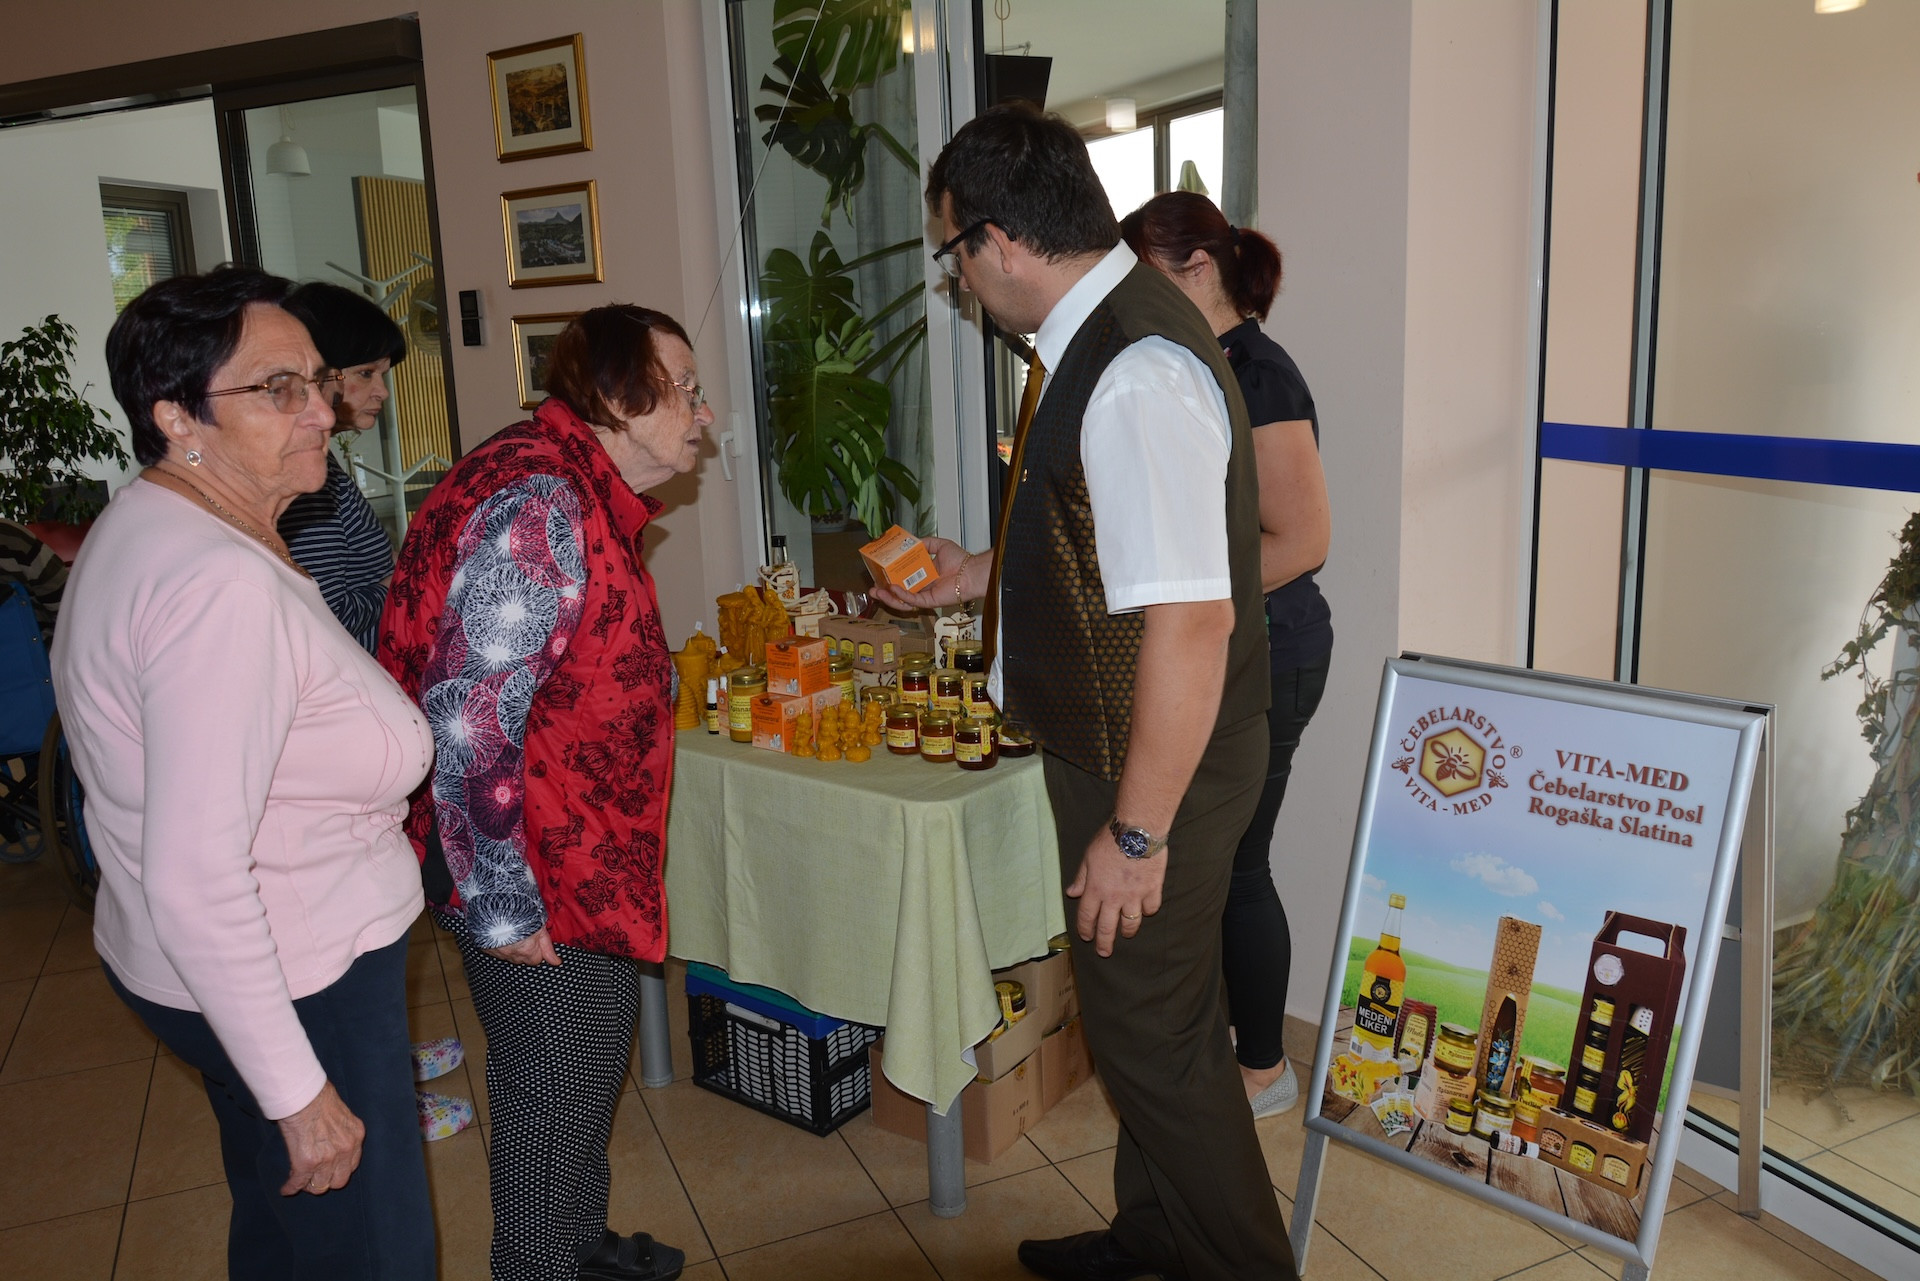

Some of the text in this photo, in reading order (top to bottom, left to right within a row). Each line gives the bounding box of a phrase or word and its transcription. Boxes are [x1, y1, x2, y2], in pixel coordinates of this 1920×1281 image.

[1399, 706, 1506, 769] ČEBELARSTVO
[1555, 749, 1690, 792] VITA-MED
[1528, 769, 1705, 824] Čebelarstvo Posl
[1528, 796, 1694, 848] Rogaška Slatina
[1358, 1006, 1393, 1026] MEDENI
[1360, 1017, 1388, 1034] LIKER
